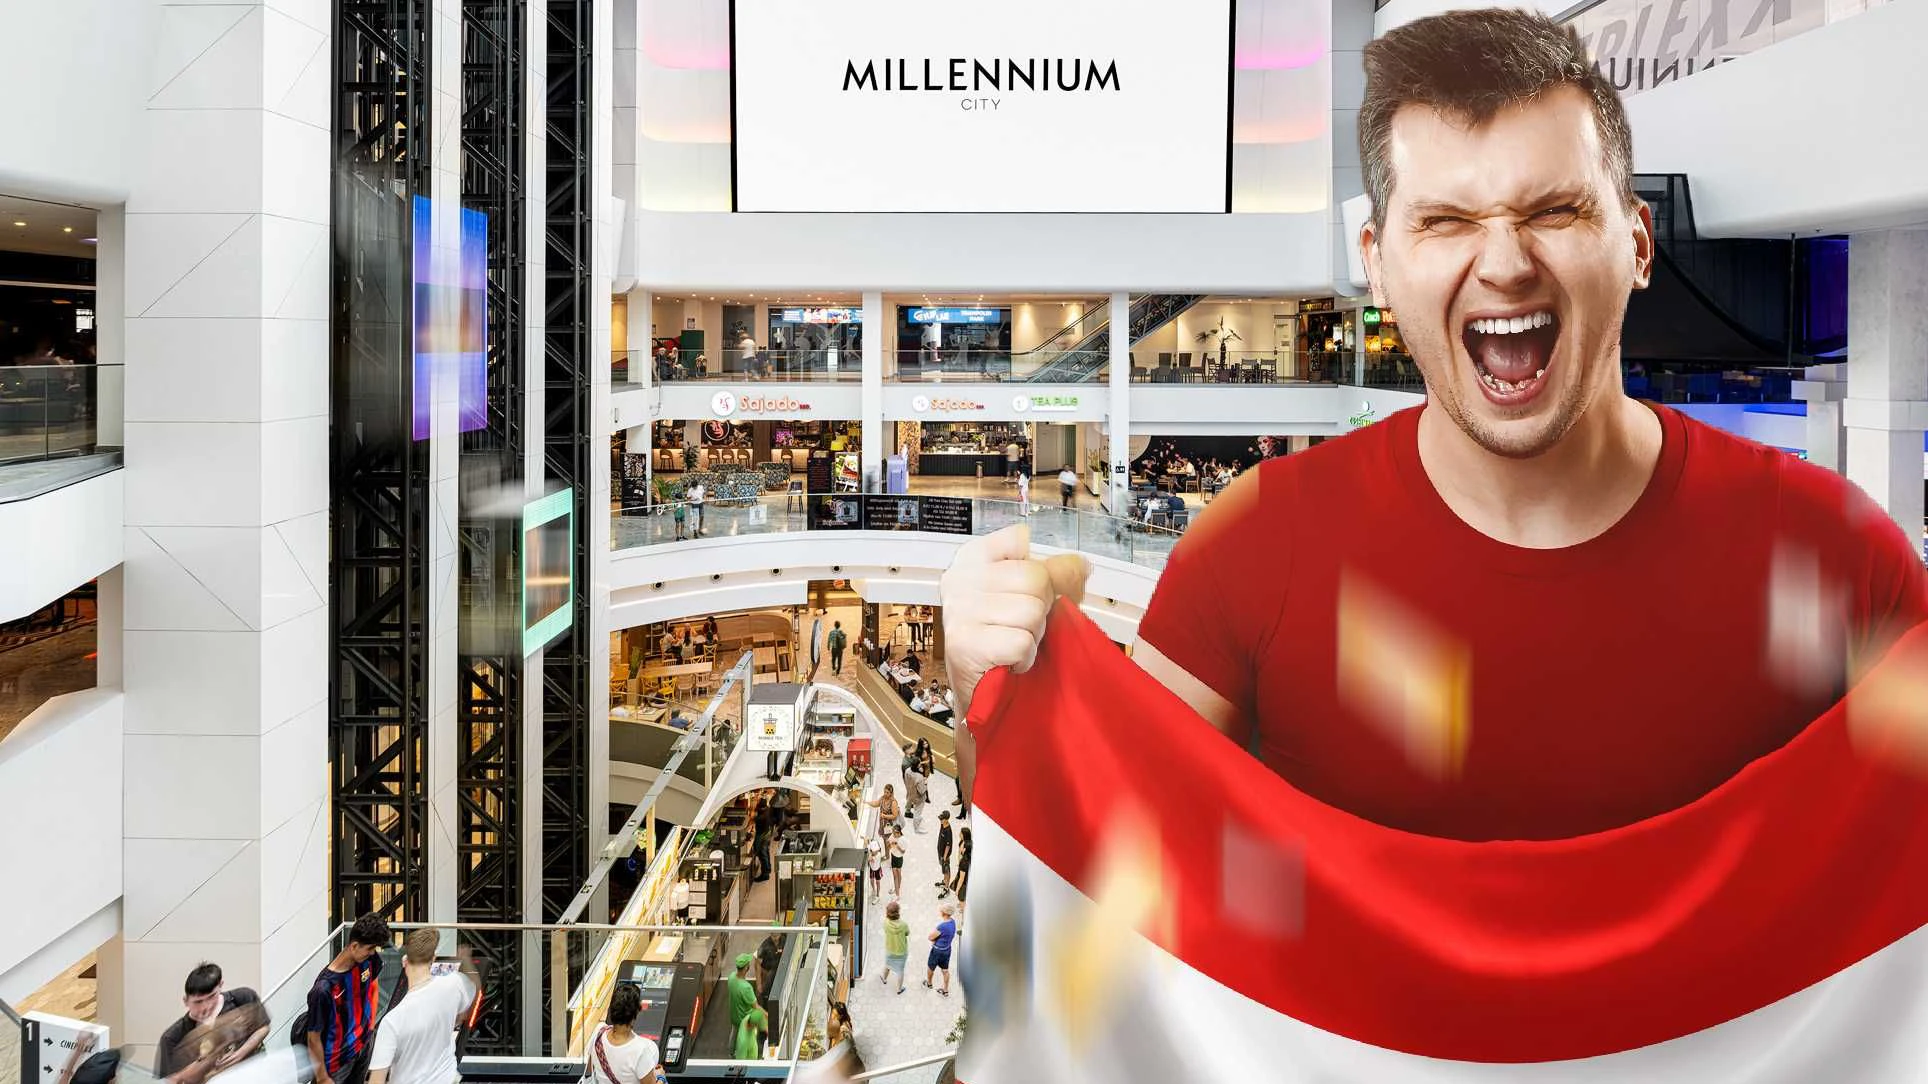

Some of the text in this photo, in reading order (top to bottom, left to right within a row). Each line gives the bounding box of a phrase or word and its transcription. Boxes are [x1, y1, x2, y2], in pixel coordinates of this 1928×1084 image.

[842, 58, 1120, 91] MILLENNIUM
[961, 98, 1001, 110] CITY
[739, 395, 800, 415] Sajado
[930, 398, 976, 413] Sajado
[1031, 396, 1078, 407] TEA PLUS
[26, 1022, 33, 1041] 1
